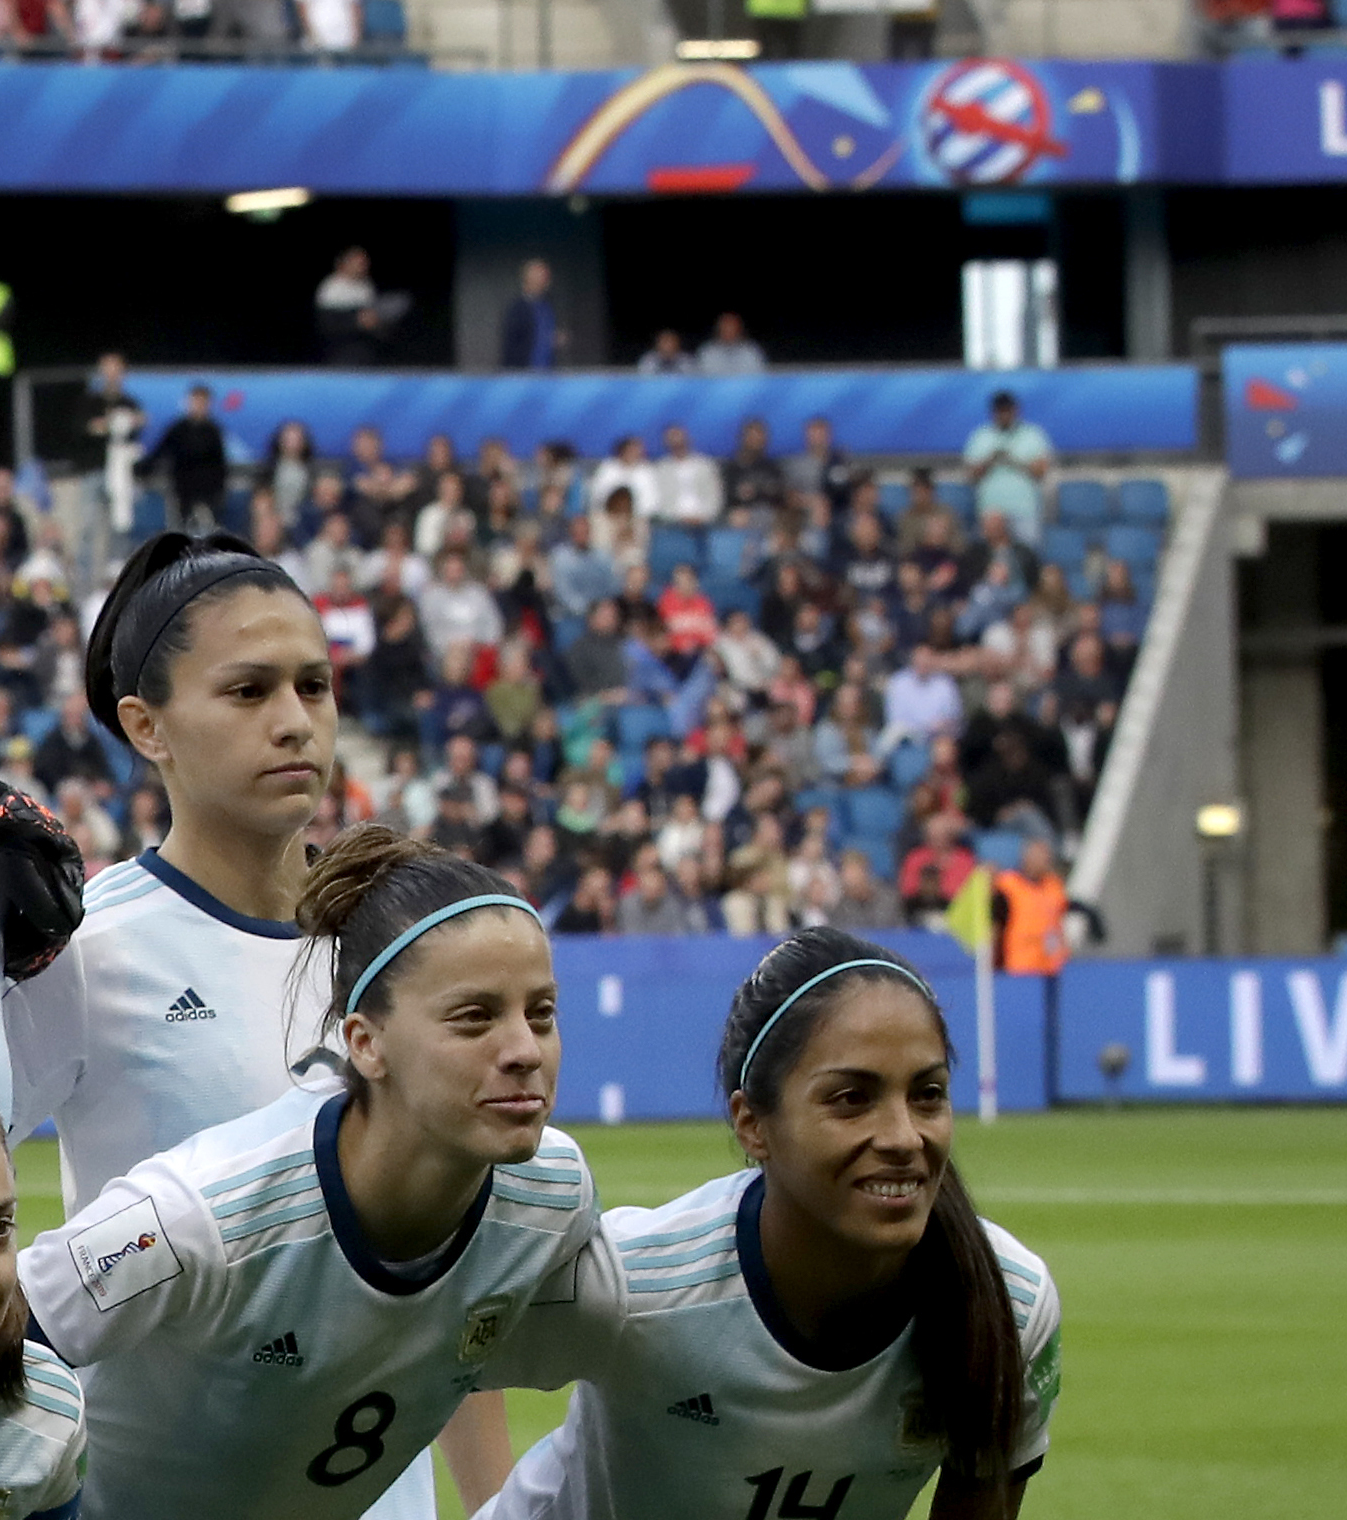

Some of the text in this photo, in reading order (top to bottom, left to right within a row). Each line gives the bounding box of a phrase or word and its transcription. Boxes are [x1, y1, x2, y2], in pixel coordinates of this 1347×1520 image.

[165, 1008, 216, 1022] adidas
[253, 1351, 304, 1367] adidas
[667, 1405, 719, 1426] adidas
[306, 1390, 396, 1486] 8
